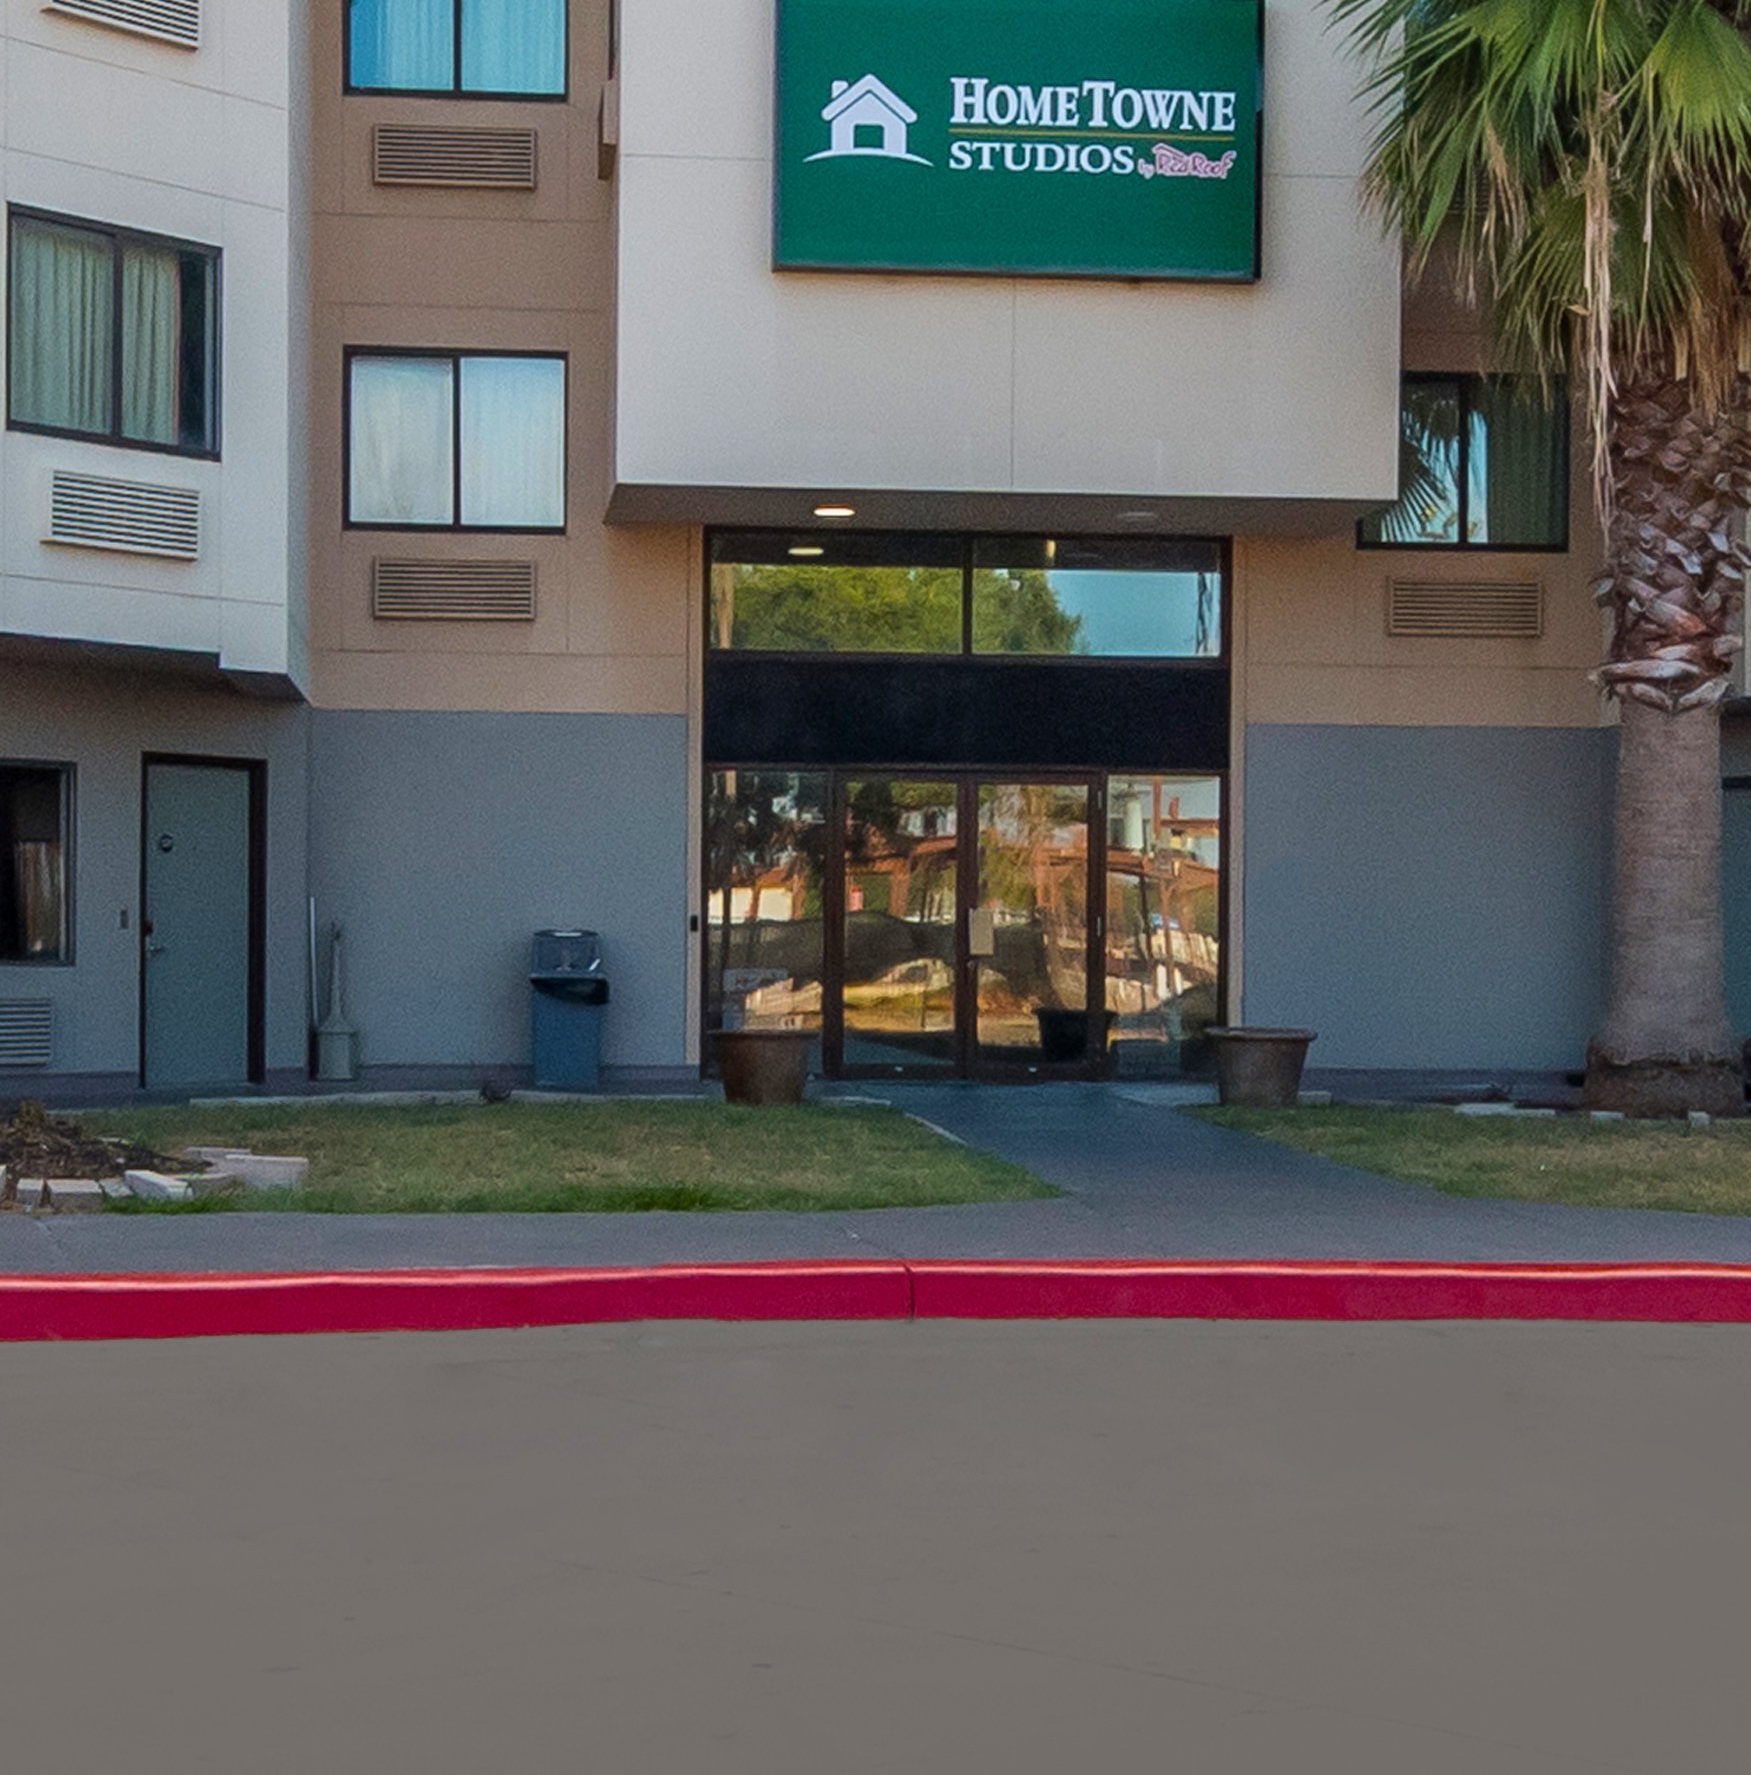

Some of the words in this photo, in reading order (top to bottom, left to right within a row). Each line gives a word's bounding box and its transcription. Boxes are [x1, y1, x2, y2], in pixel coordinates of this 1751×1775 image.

[949, 141, 1135, 174] STUDIOS
[1155, 151, 1189, 176] Red
[1189, 151, 1237, 179] Roof
